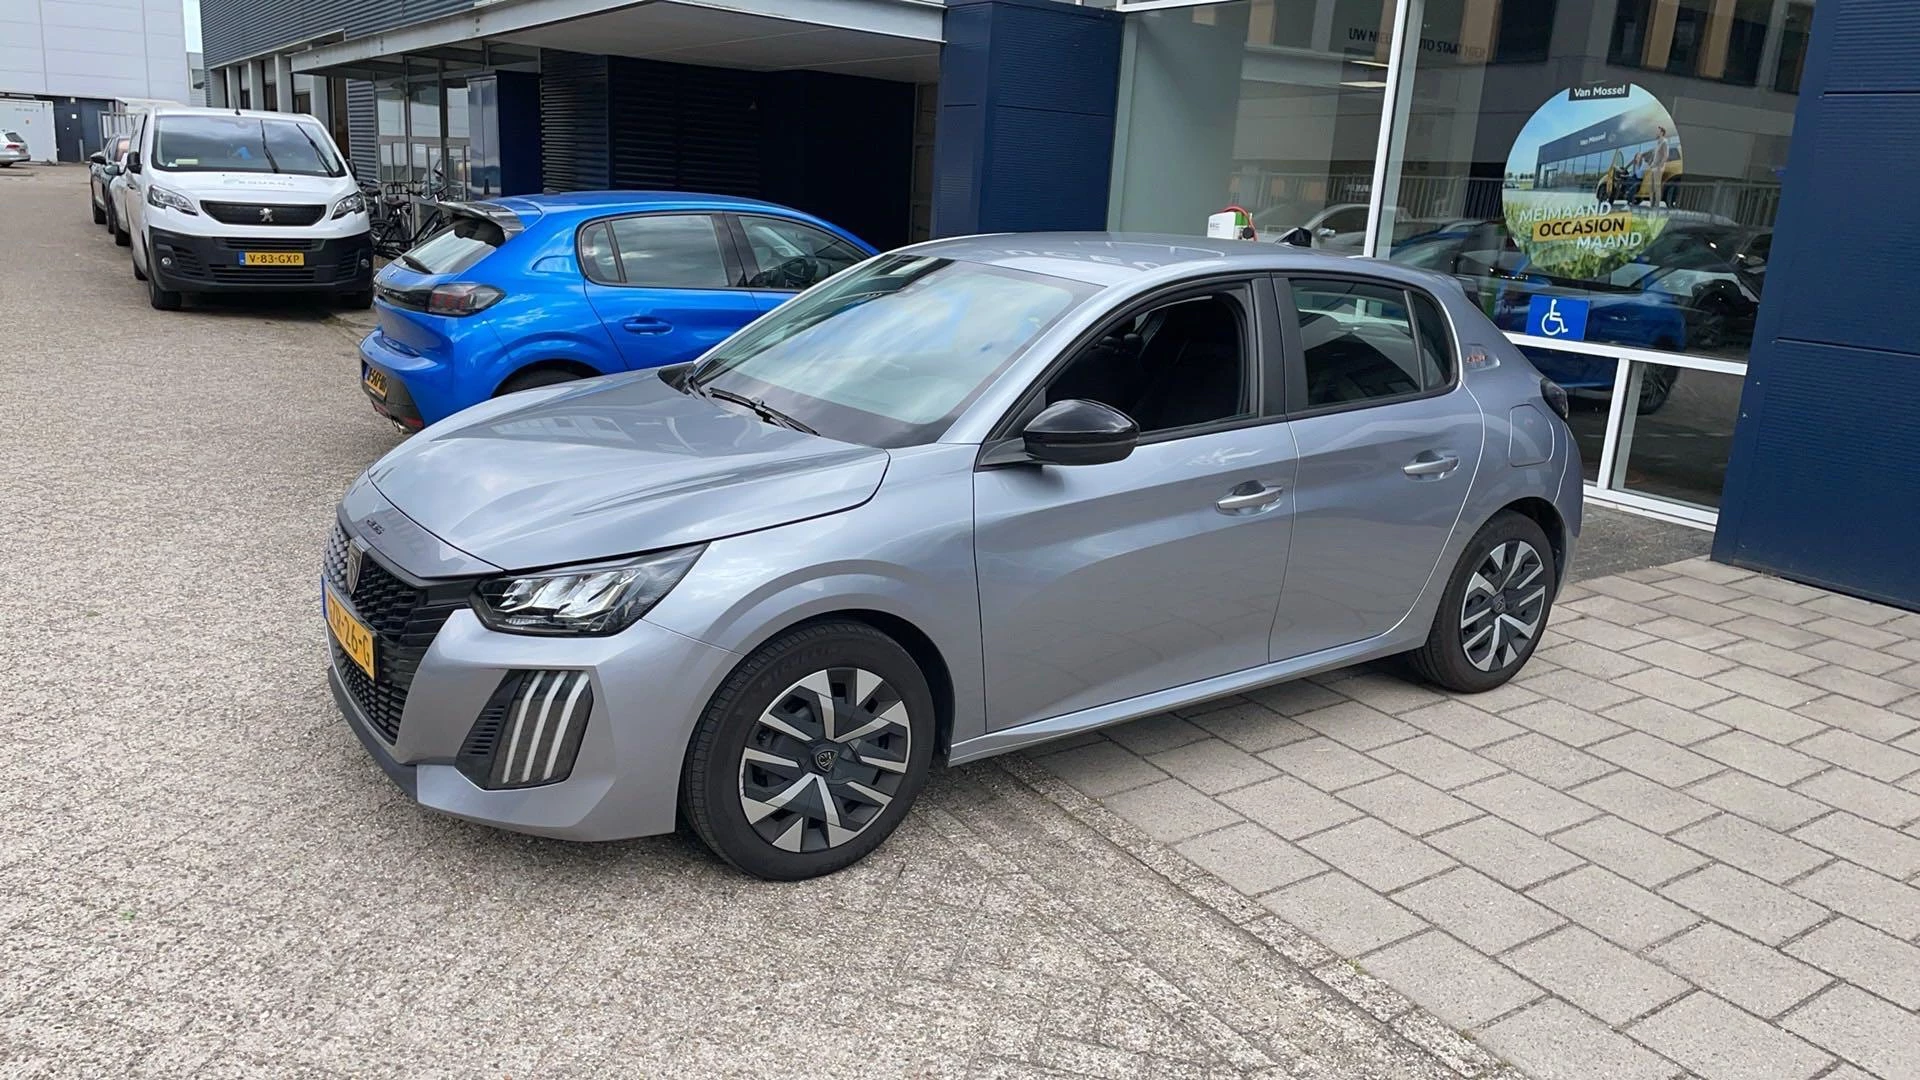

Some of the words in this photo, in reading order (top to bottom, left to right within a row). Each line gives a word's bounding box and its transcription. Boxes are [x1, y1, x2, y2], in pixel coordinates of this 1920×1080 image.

[1573, 88, 1591, 98] Van
[1592, 84, 1626, 97] Mossel
[1519, 200, 1612, 222] MEIMAAND
[1539, 217, 1626, 237] OCCASION
[1576, 231, 1643, 251] MAAND
[248, 254, 300, 264] V-83-GXP
